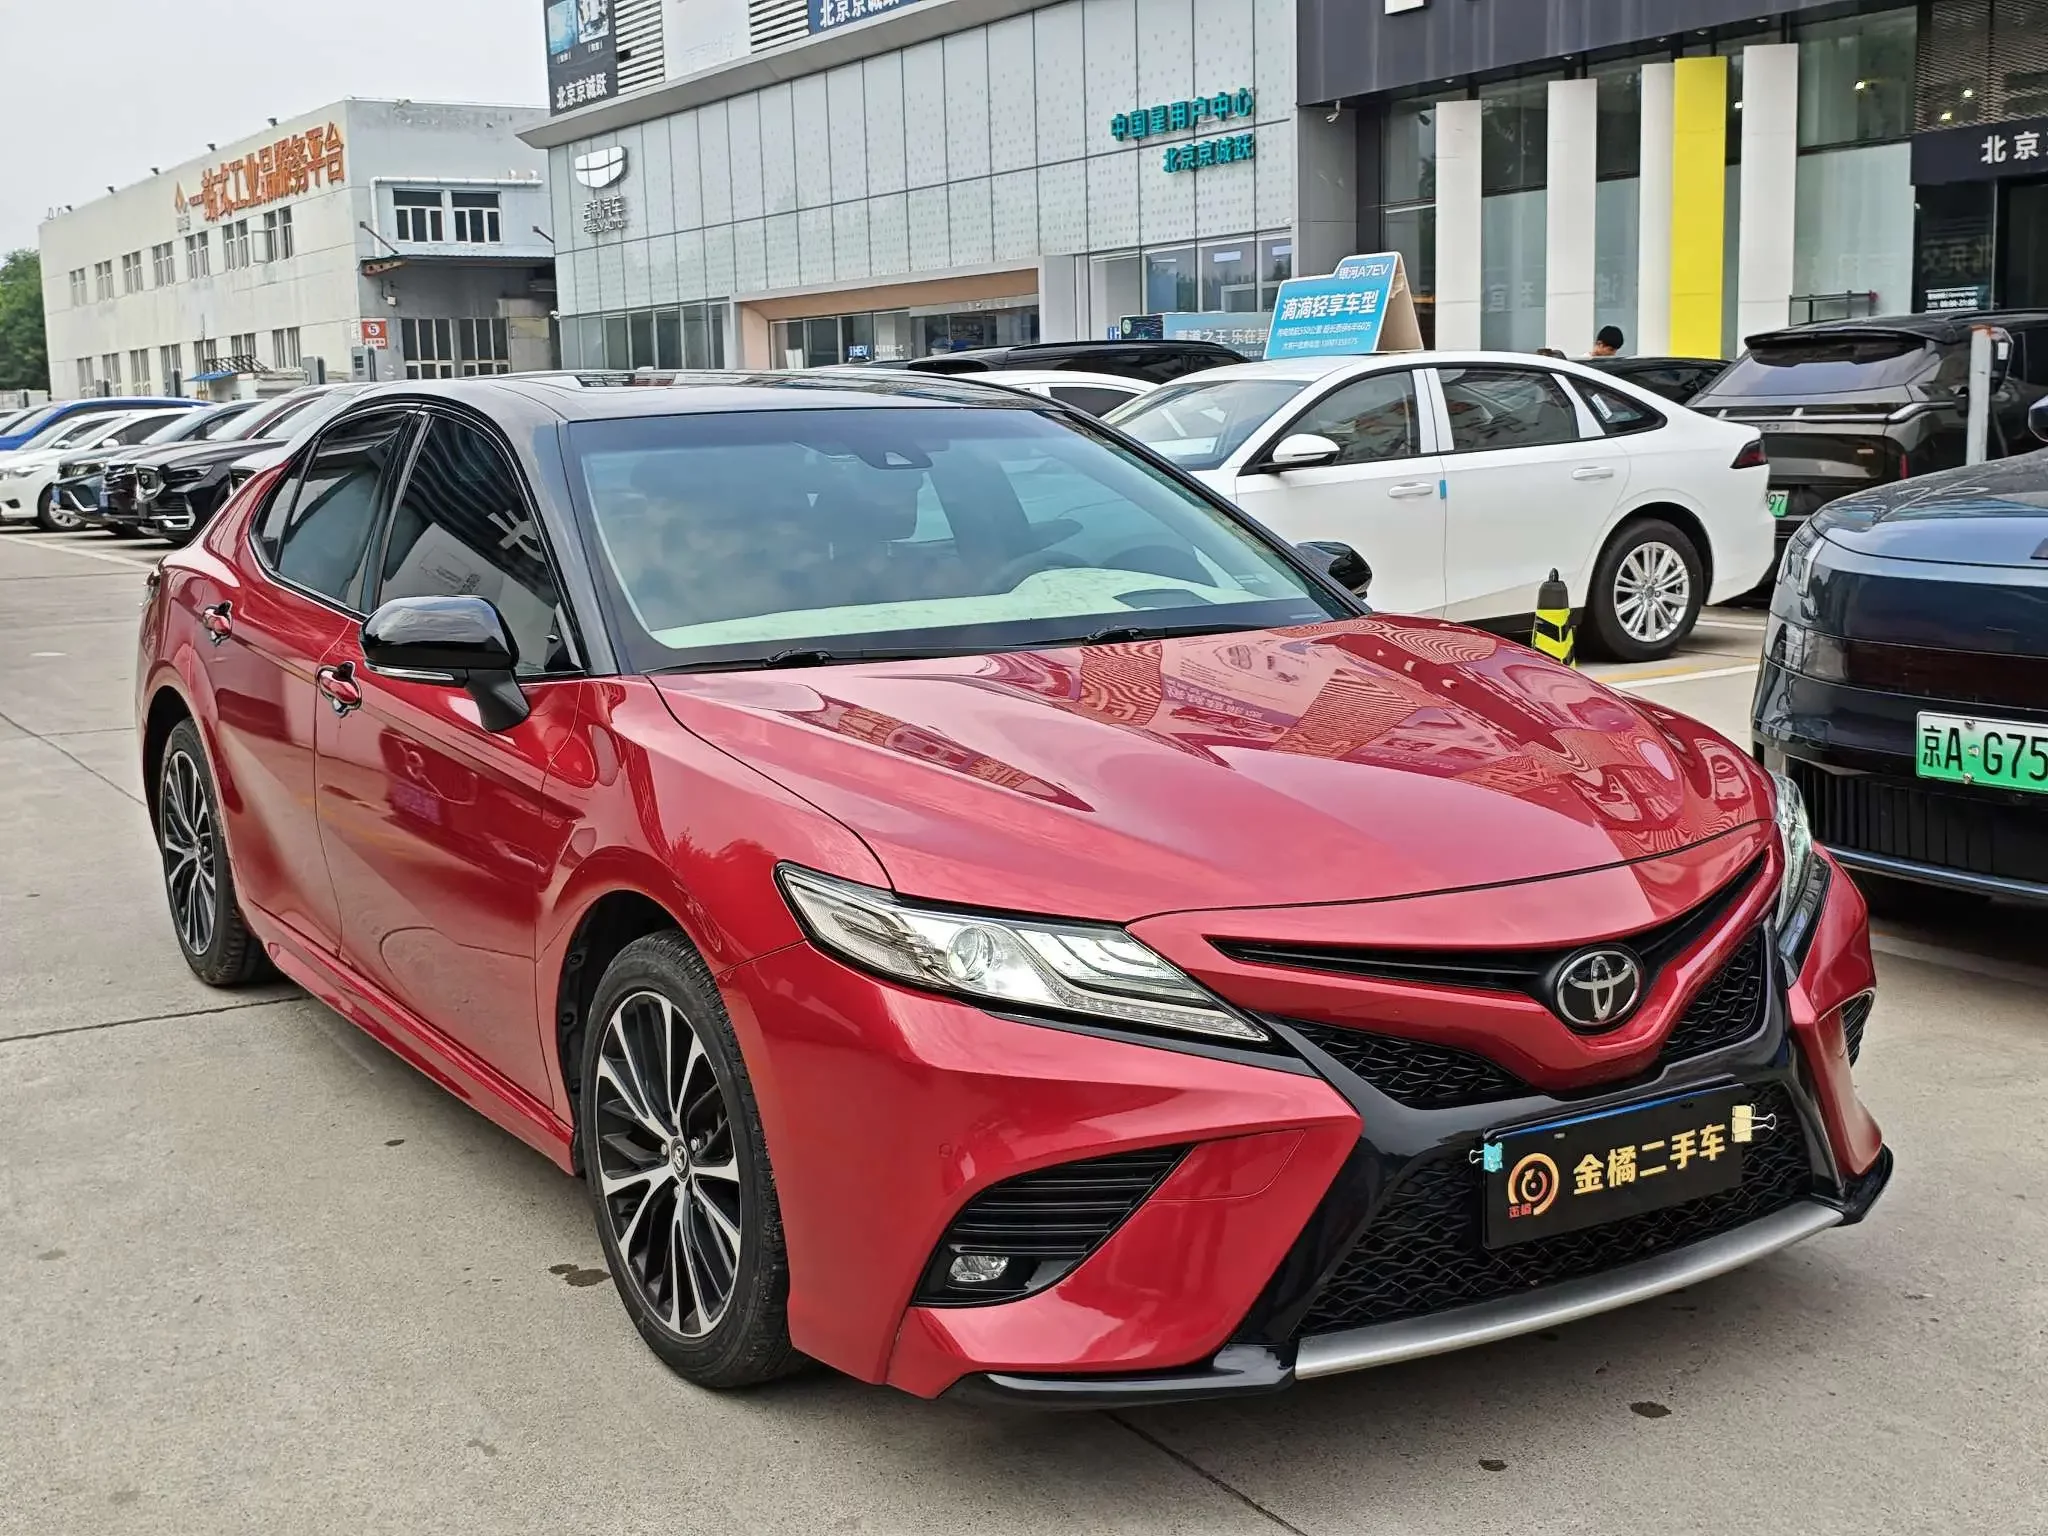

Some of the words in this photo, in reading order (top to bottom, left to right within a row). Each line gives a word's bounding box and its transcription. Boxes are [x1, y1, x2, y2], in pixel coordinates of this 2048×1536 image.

[1111, 88, 1253, 142] 中国星用户中心
[1163, 134, 1254, 173] 北京京诚跃
[1981, 131, 2048, 164] 北京
[189, 121, 345, 222] 一站式工业品服务平台
[1281, 289, 1380, 320] 滴滴轻享车型
[1765, 494, 1786, 512] 97
[1573, 1124, 1725, 1195] 金橘二手车
